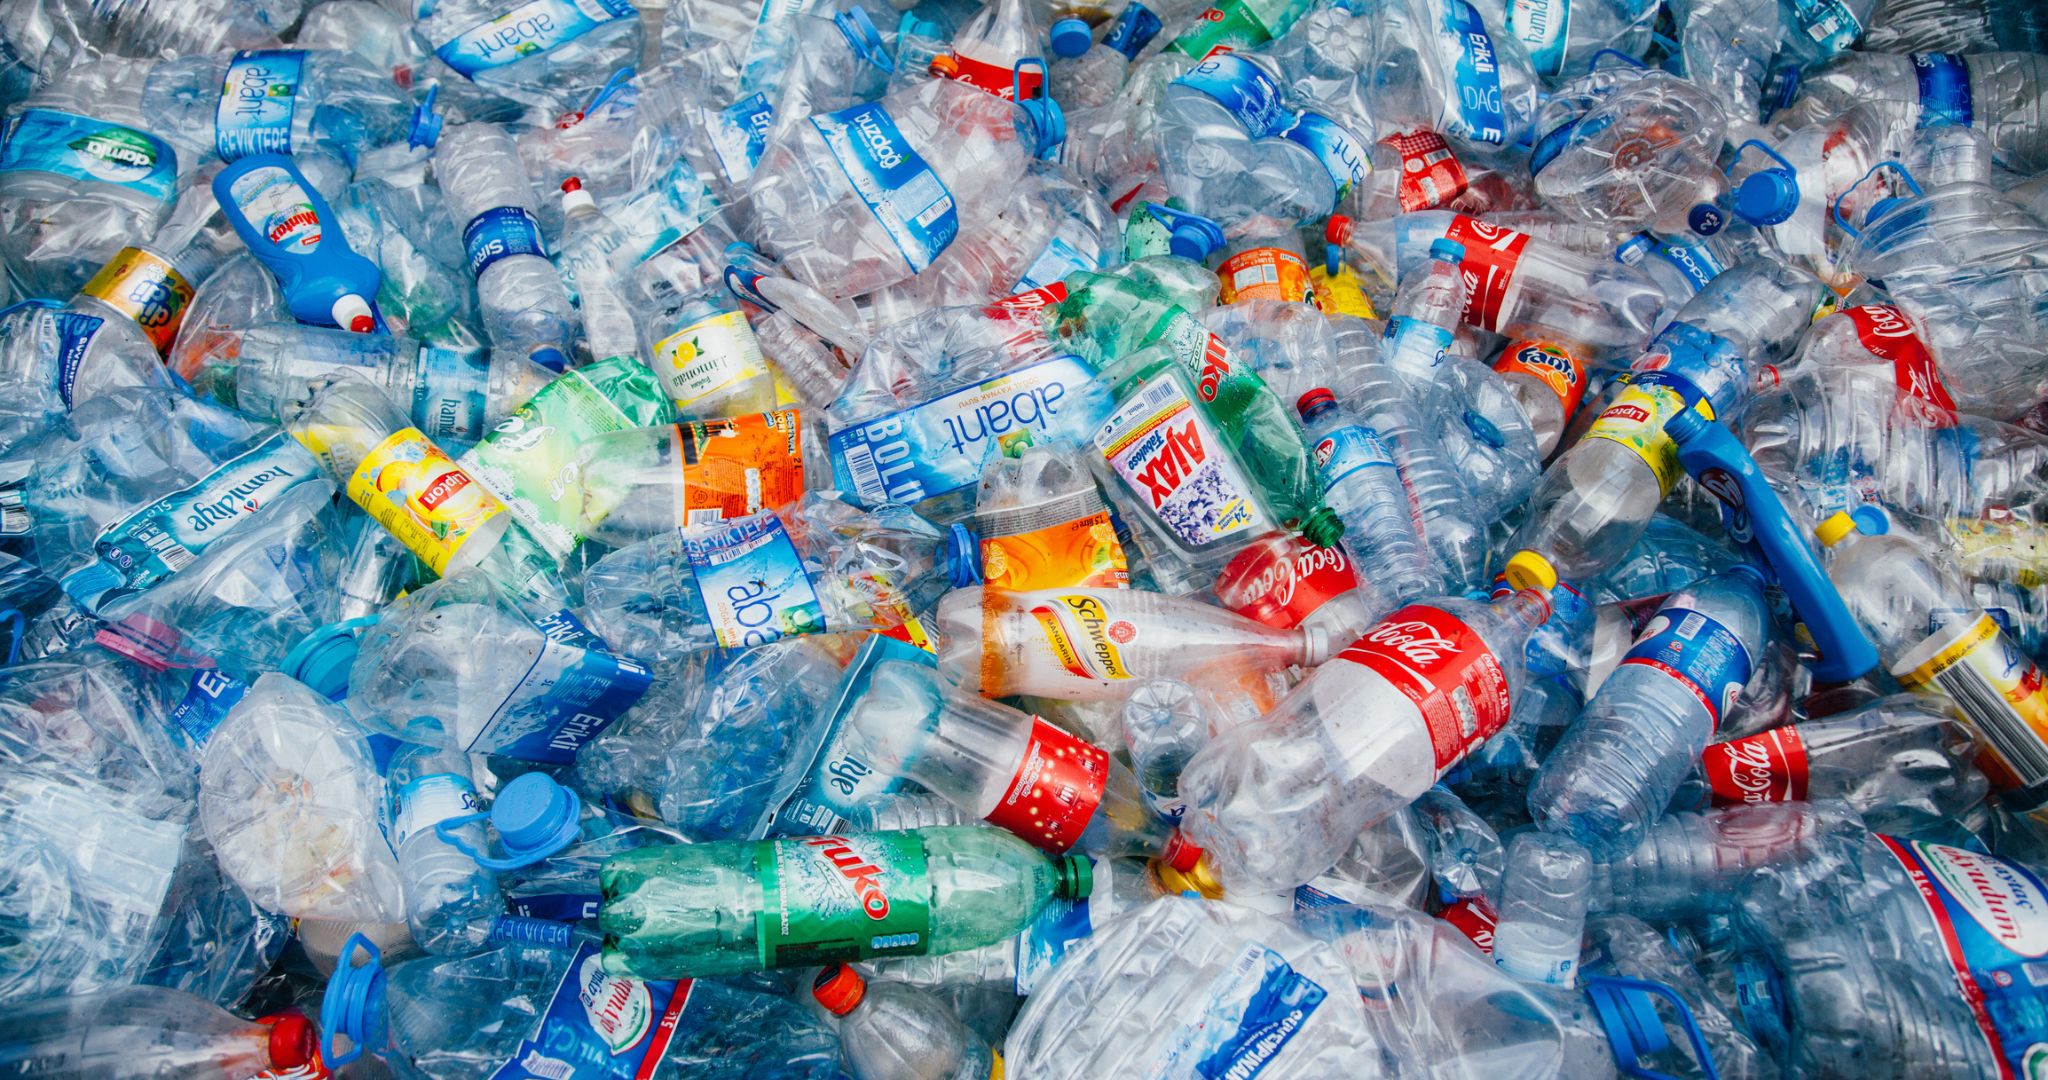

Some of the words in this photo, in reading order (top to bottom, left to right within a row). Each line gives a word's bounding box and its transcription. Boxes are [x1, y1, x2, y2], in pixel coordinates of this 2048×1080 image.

[478, 13, 555, 59] abant
[1523, 0, 1548, 44] hamid
[1468, 32, 1495, 75] Erikli
[236, 66, 273, 117] abant
[86, 139, 153, 168] damla
[854, 111, 903, 169] buzdağı
[1333, 136, 1366, 180] ant
[268, 211, 319, 246] Mintax
[468, 239, 504, 279] SIRM
[1669, 245, 1709, 288] zdağı
[672, 354, 728, 388] Limonata
[1518, 345, 1578, 387] Fanta
[944, 381, 1066, 456] abant
[1601, 405, 1647, 423] Lipton
[870, 416, 922, 506] BOLU
[1129, 430, 1165, 470] Fabuloso
[1136, 418, 1207, 509] AJAX
[187, 464, 295, 532] hamidiye
[424, 472, 469, 506] Lipton
[729, 580, 779, 648] aba
[1046, 617, 1073, 665] MANDARIN
[1067, 597, 1118, 678] Schweppes
[549, 712, 604, 752] Erikli
